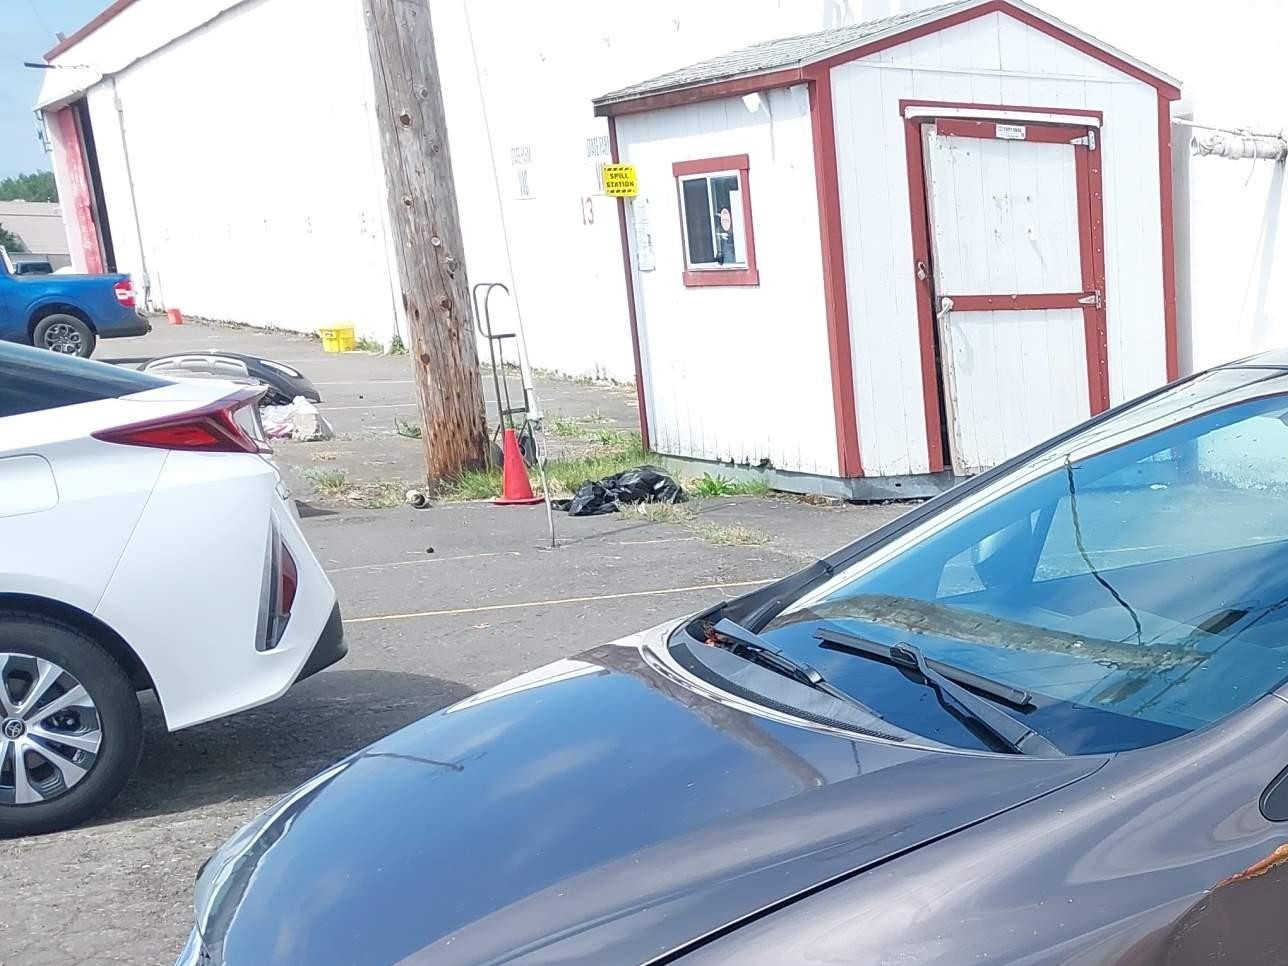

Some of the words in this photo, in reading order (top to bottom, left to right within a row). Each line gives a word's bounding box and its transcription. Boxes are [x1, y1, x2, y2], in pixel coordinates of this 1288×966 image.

[609, 172, 628, 180] SPILL
[606, 180, 634, 188] STATION
[581, 196, 594, 226] 13
